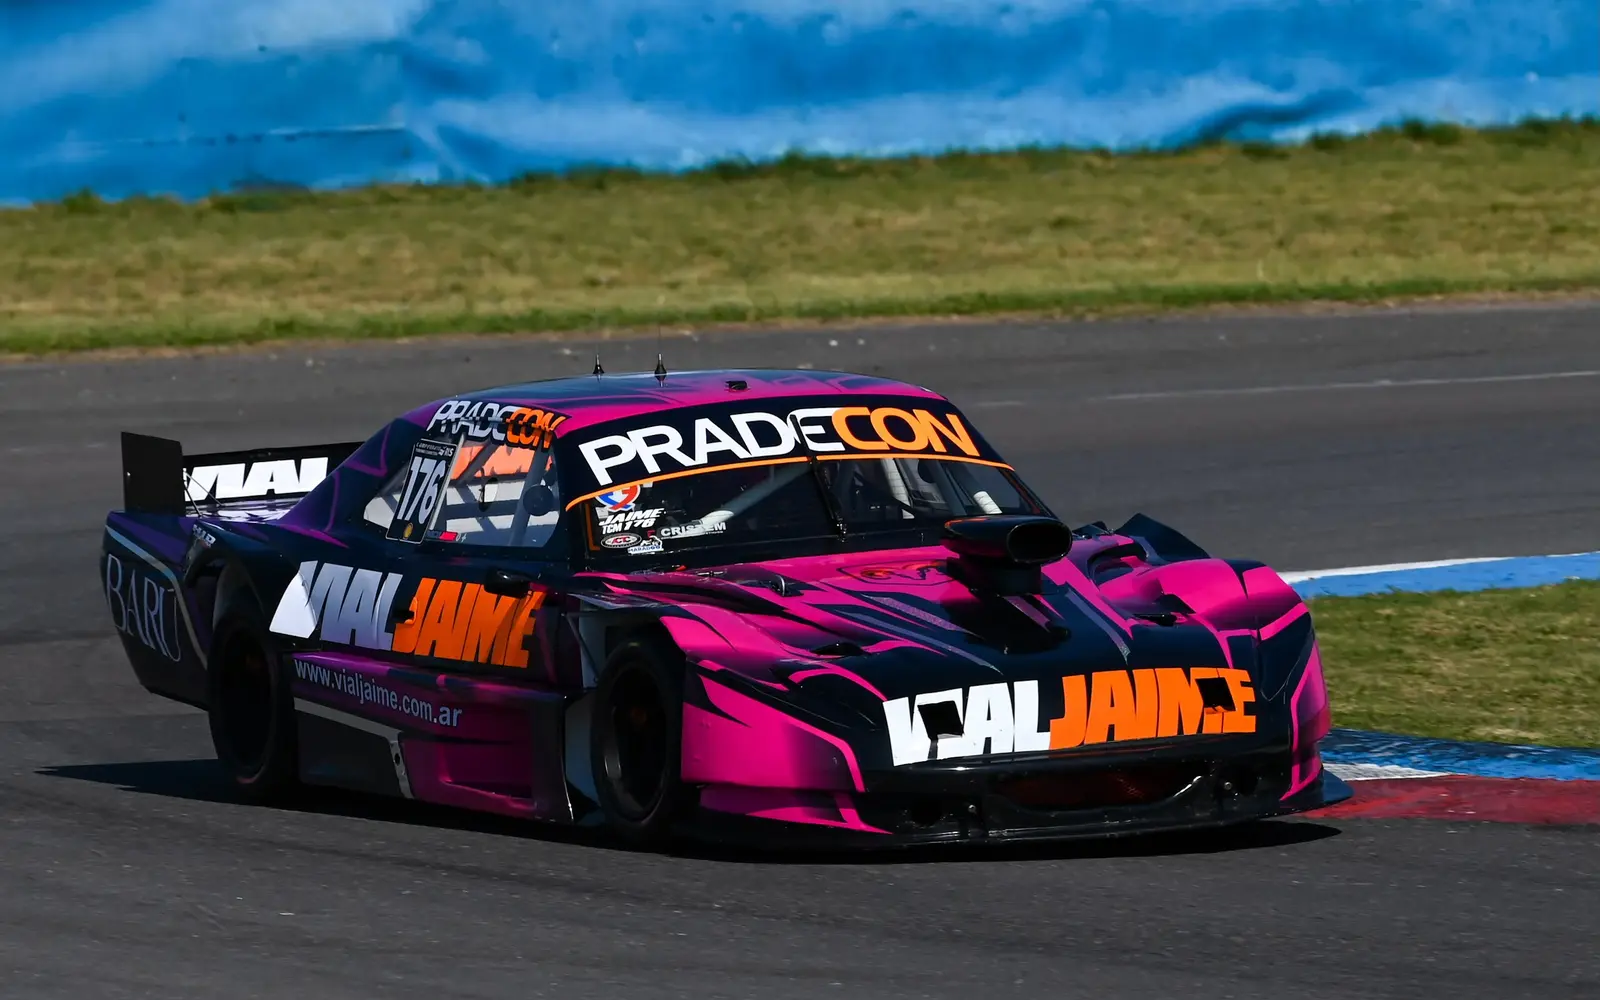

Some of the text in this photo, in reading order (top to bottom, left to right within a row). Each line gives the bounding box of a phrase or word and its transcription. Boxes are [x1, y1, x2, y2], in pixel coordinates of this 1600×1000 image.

[426, 400, 566, 449] PRADECON
[577, 406, 981, 486] PRADECON
[397, 456, 446, 524] 176
[598, 508, 665, 527] JAIME
[602, 518, 656, 535] TCM 176
[106, 553, 181, 662] BARU
[294, 659, 463, 727] www.vialjaime.com.ar
